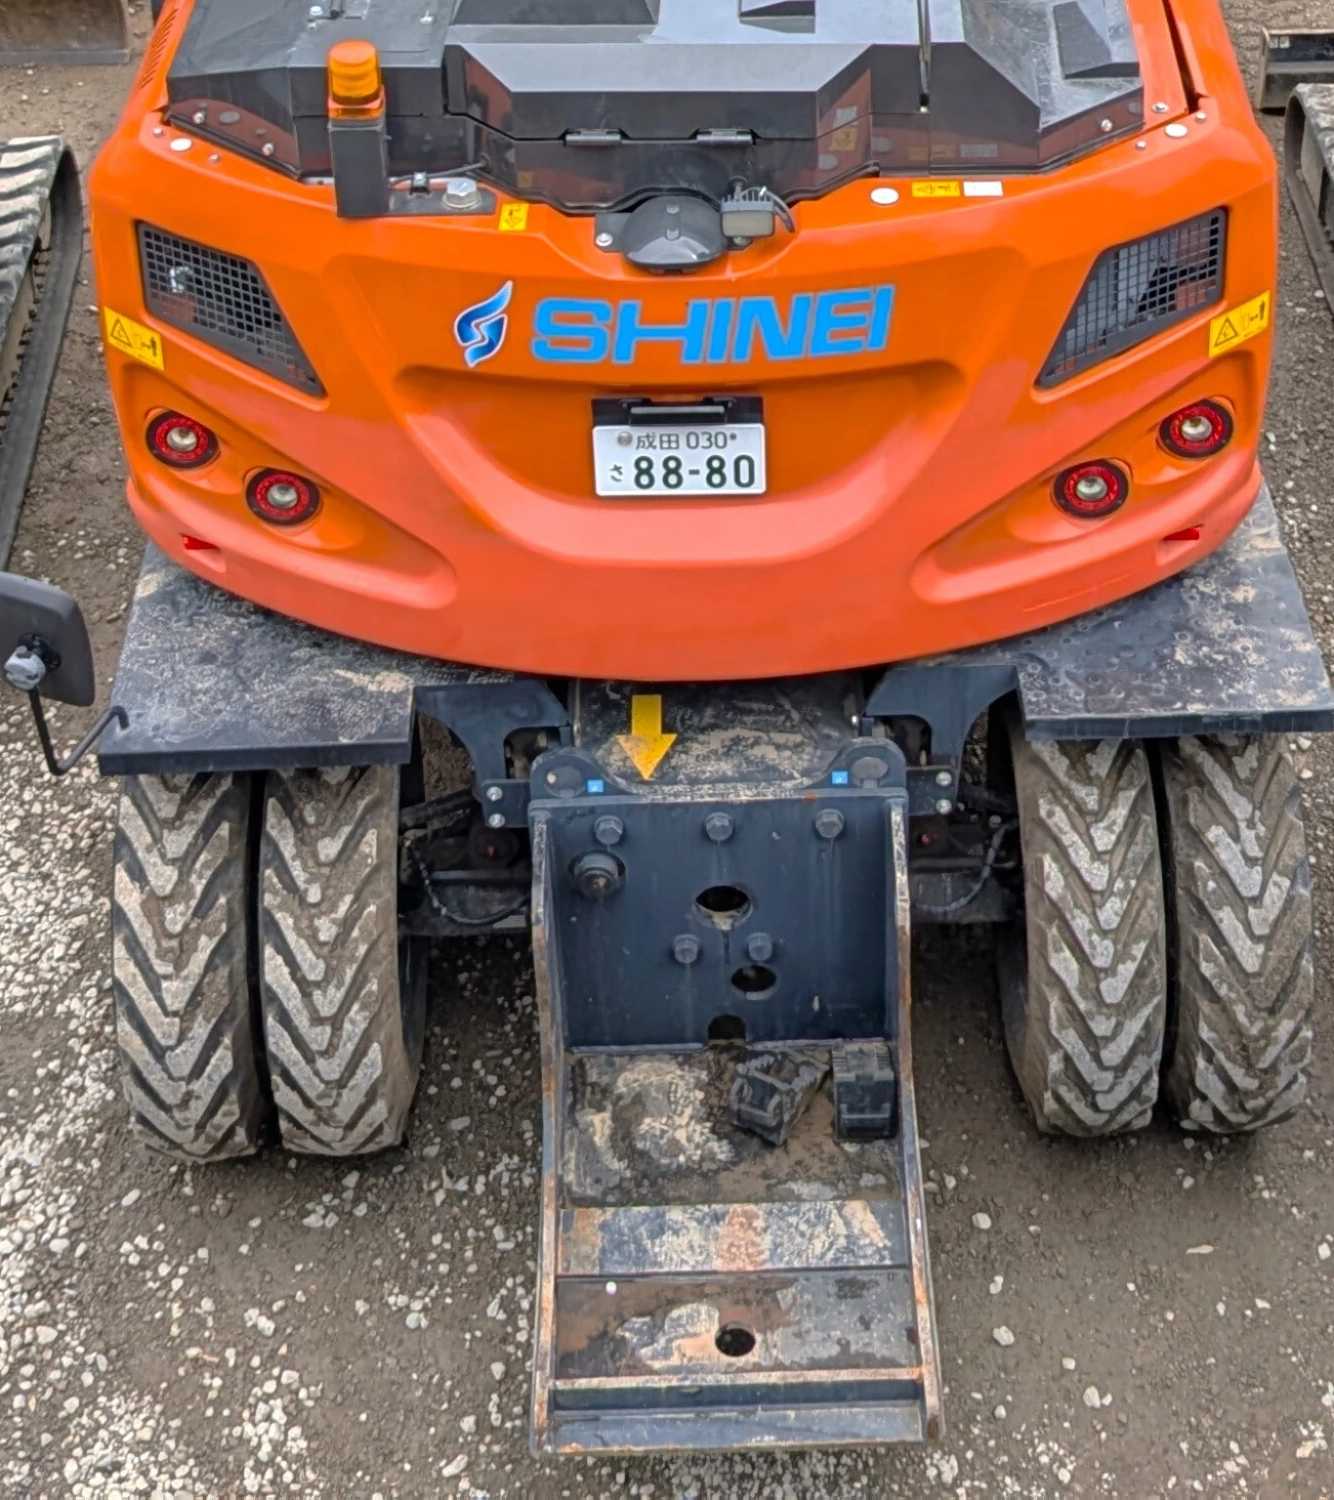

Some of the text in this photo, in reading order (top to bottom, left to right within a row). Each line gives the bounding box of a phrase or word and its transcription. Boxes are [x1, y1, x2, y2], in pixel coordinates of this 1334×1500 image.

[530, 284, 895, 364] SHINEI
[635, 431, 728, 450] 成田 030
[608, 454, 756, 490] さ 88-80
